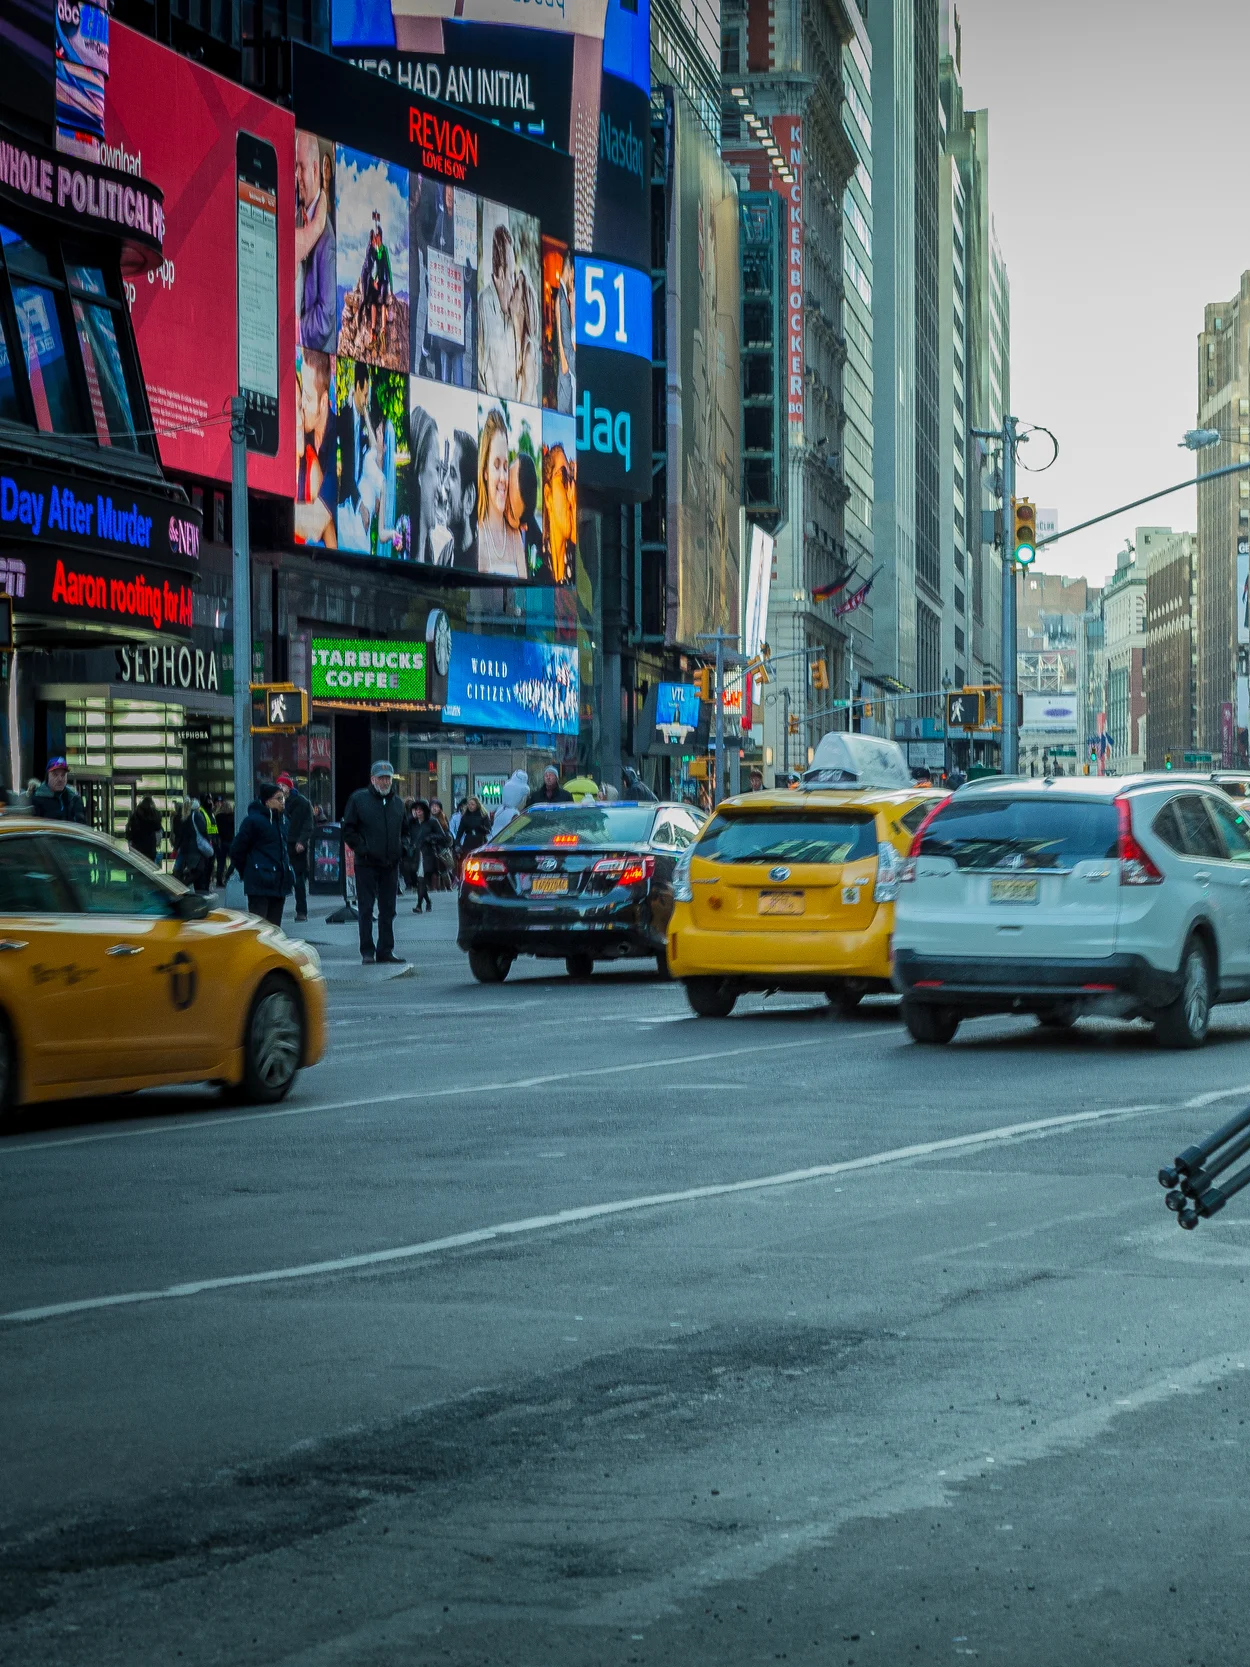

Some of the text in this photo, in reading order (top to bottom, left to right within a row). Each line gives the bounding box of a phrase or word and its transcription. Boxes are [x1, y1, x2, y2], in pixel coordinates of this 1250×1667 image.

[57, 1, 80, 25] abc
[398, 61, 440, 99] HAD
[446, 65, 472, 104] AN
[478, 67, 535, 110] INITIAL
[409, 106, 478, 167] REVLON
[600, 113, 644, 188] Nasdaq
[100, 142, 142, 178] ownload
[422, 150, 466, 180] LOVE IS ON
[57, 166, 152, 234] POLITICAL
[789, 125, 802, 396] KNICKERBOCKER
[585, 265, 628, 343] 51
[1, 476, 152, 548] Day After Murder
[52, 559, 107, 609] Aaron
[110, 574, 161, 629] rooting
[164, 580, 178, 623] for
[122, 644, 218, 690] SEPHORA
[312, 649, 423, 669] STARBUCKS
[326, 670, 399, 688] COFFEE
[471, 657, 508, 679] WORLD
[467, 683, 512, 703] CITIZEN
[178, 731, 209, 740] SEPHORA
